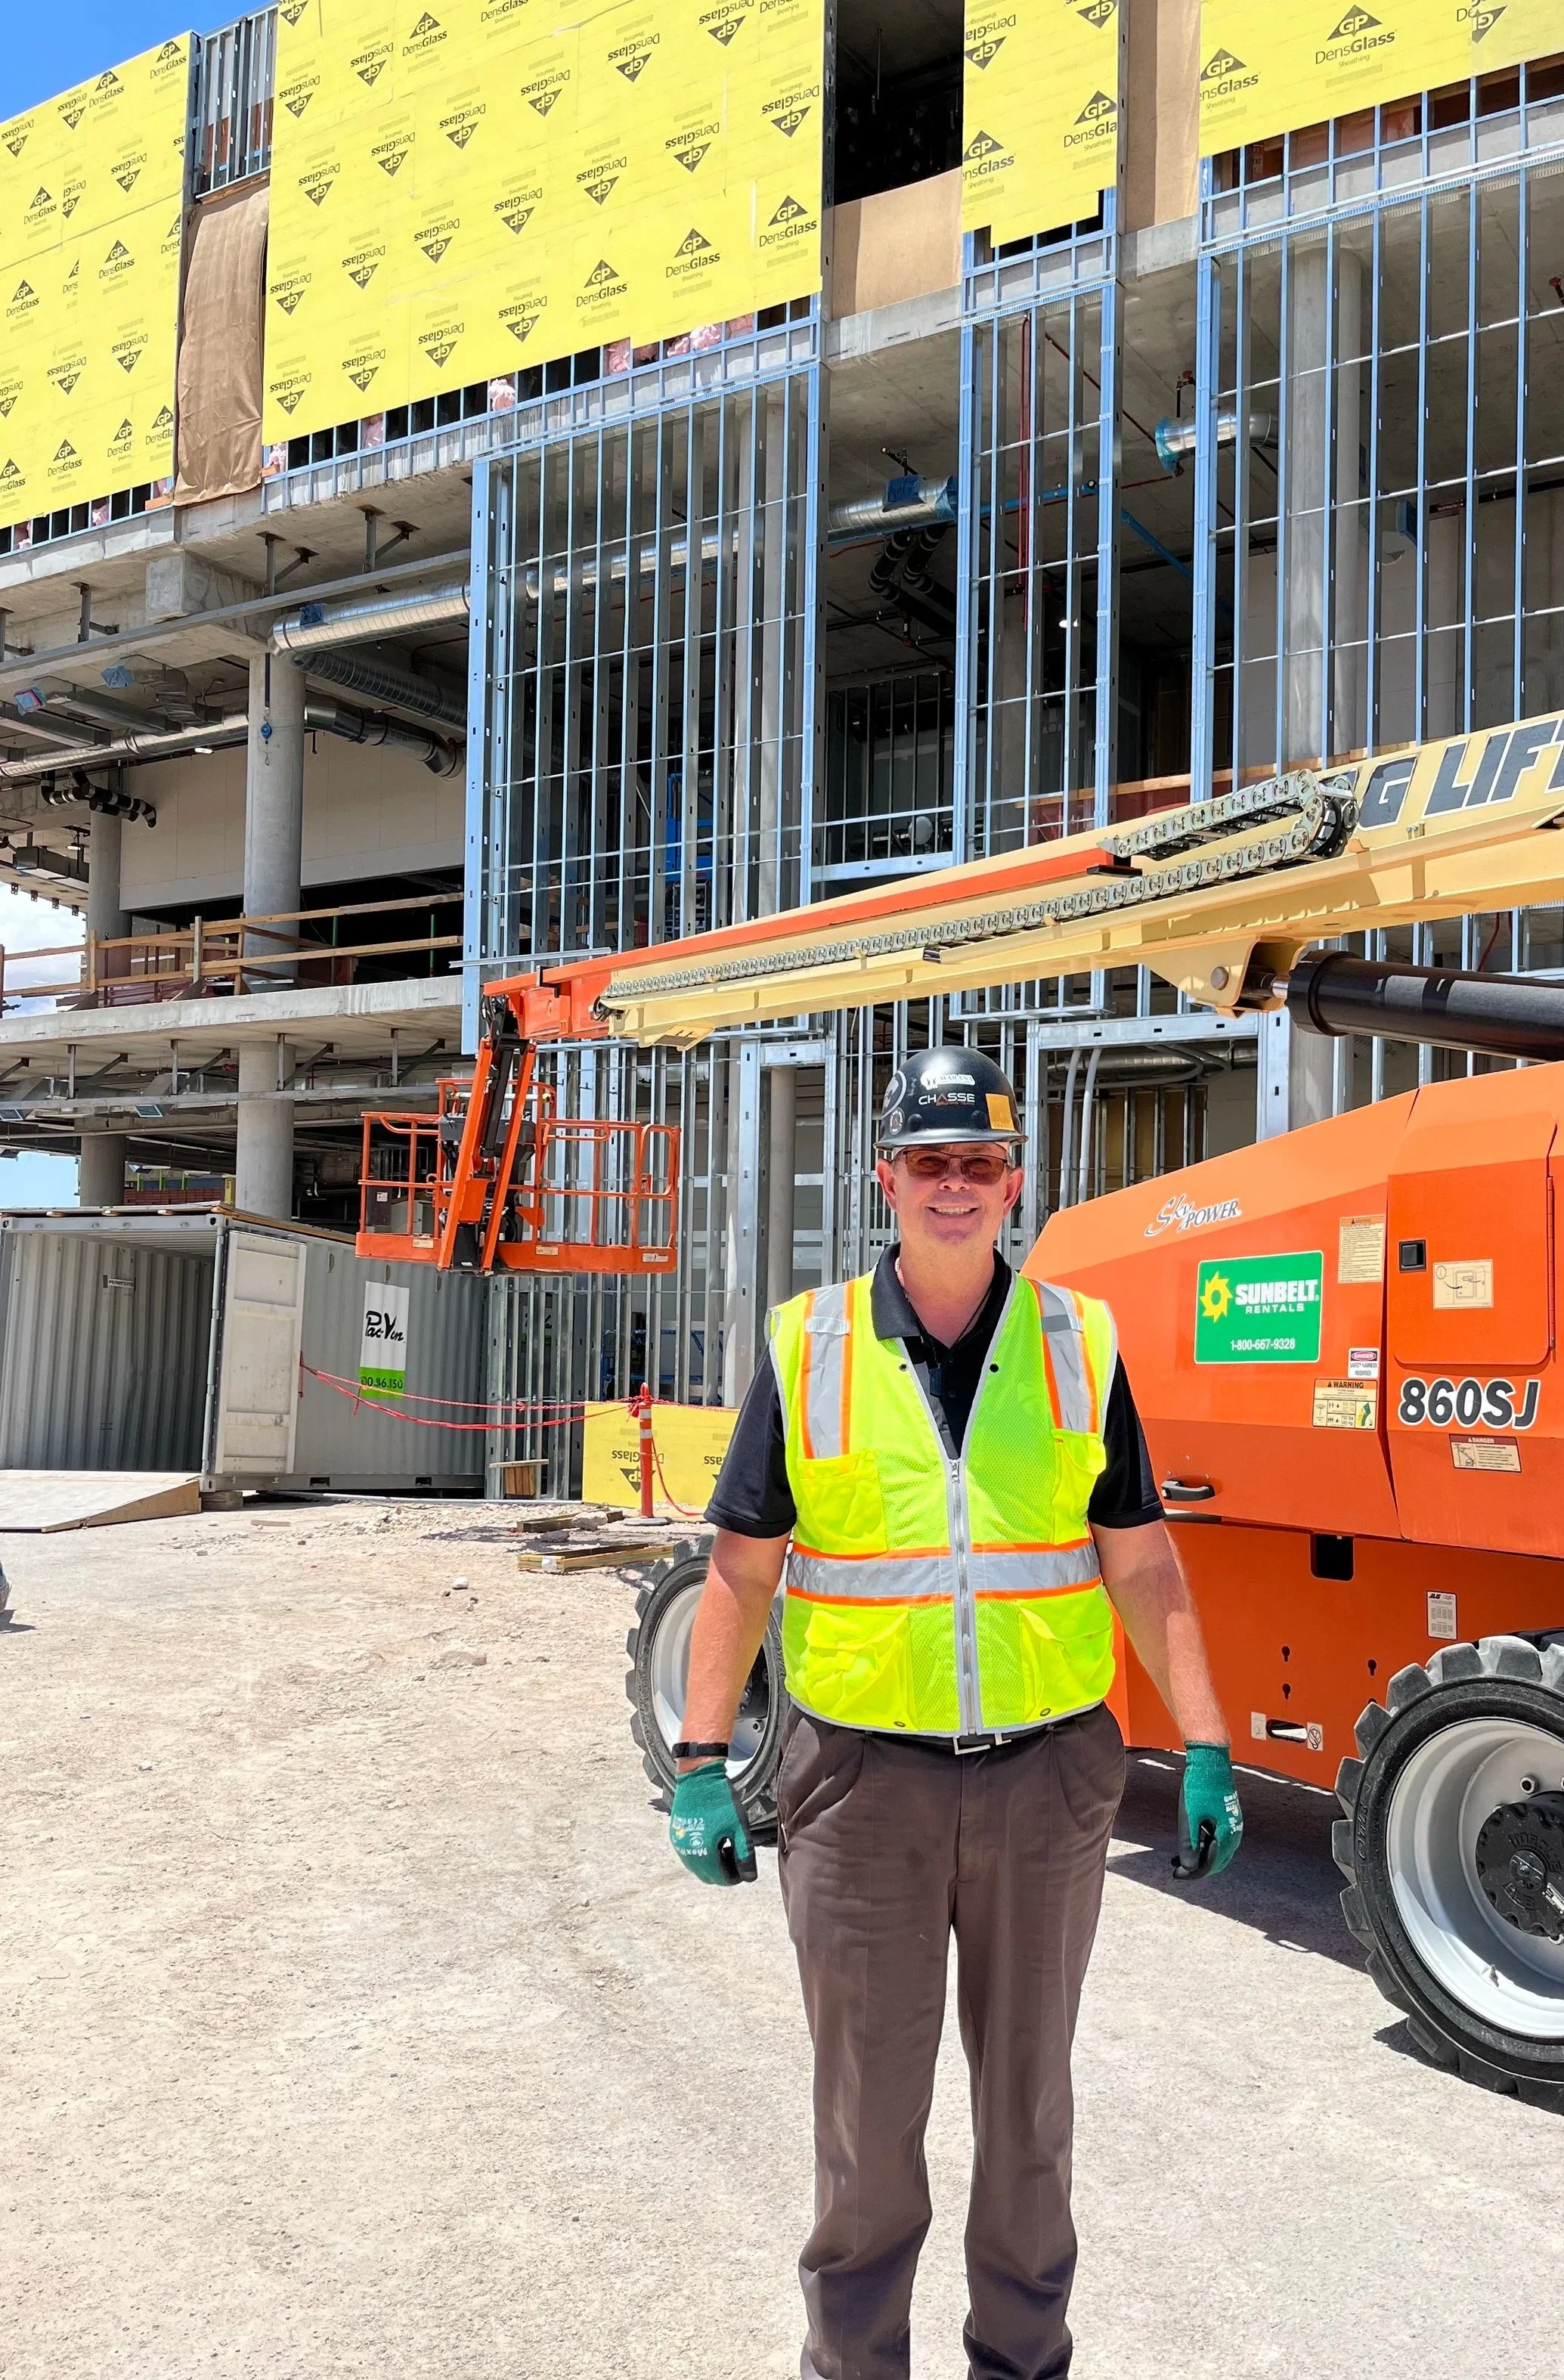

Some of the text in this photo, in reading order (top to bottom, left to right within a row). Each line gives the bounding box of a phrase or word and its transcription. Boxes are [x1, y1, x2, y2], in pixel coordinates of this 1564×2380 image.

[287, 5, 303, 19] GP
[1088, 2, 1114, 20] GP
[415, 17, 433, 34] GP
[717, 20, 739, 38] GP
[1338, 14, 1369, 35] GP
[161, 43, 175, 57] GP
[402, 31, 448, 57] DensGlass
[606, 33, 660, 64] DensGlass
[972, 43, 997, 61] GP
[1315, 29, 1397, 64] DensGlass
[349, 42, 393, 70] DensGlass
[150, 55, 187, 79] DensGlass
[364, 64, 380, 80] GP
[624, 59, 645, 75] GP
[1206, 57, 1234, 76] GP
[99, 75, 113, 88] GP
[279, 75, 320, 99] DensGlass
[521, 70, 570, 96] DensGlass
[89, 85, 124, 108] DensGlass
[291, 95, 307, 110] GP
[535, 94, 555, 110] GP
[760, 85, 819, 116] DensGlass
[438, 104, 486, 130] DensGlass
[1084, 99, 1111, 119] GP
[2, 119, 34, 141] DensGlass
[780, 113, 803, 130] GP
[453, 126, 471, 142] GP
[664, 122, 720, 151] DensGlass
[11, 138, 25, 151] GP
[370, 132, 415, 158] DensGlass
[968, 139, 993, 158] GP
[110, 153, 147, 176] DensGlass
[386, 153, 403, 169] GP
[682, 148, 704, 164] GP
[121, 172, 135, 186] GP
[299, 163, 340, 186] DensGlass
[574, 156, 627, 184] DensGlass
[311, 184, 328, 200] GP
[592, 182, 612, 197] GP
[35, 194, 48, 206] GP
[492, 187, 542, 214] DensGlass
[24, 204, 57, 225] DensGlass
[509, 211, 528, 227] GP
[775, 204, 798, 221] GP
[413, 218, 460, 243] DensGlass
[759, 219, 817, 247] DensGlass
[429, 240, 447, 256] GP
[681, 236, 703, 253] GP
[110, 247, 123, 261] GP
[342, 245, 386, 268] DensGlass
[99, 257, 136, 279] DensGlass
[665, 251, 720, 278] DensGlass
[271, 273, 311, 293] DensGlass
[356, 267, 372, 281] GP
[590, 268, 611, 284] GP
[16, 287, 29, 298] GP
[283, 293, 299, 307] GP
[576, 282, 627, 308] DensGlass
[6, 296, 40, 318] DensGlass
[497, 296, 547, 321] DensGlass
[417, 321, 464, 346] DensGlass
[513, 318, 533, 334] GP
[110, 333, 148, 355] DensGlass
[432, 343, 451, 359] GP
[123, 352, 137, 366] GP
[341, 349, 386, 370] DensGlass
[61, 374, 76, 387] GP
[270, 371, 311, 392] DensGlass
[356, 370, 373, 384] GP
[283, 393, 299, 407] GP
[156, 413, 172, 426] GP
[57, 446, 71, 457] GP
[2, 464, 17, 477] GP
[48, 458, 82, 477] DensGlass
[918, 1092, 975, 1105] CHASSE
[1185, 1200, 1239, 1229] POWER
[1235, 1279, 1318, 1305] SUNBELT
[1245, 1303, 1305, 1315] RENTALS
[1230, 1337, 1296, 1351] 1-800-667-9328
[1333, 1381, 1364, 1389] WARNING
[1399, 1377, 1541, 1430] 860SJ
